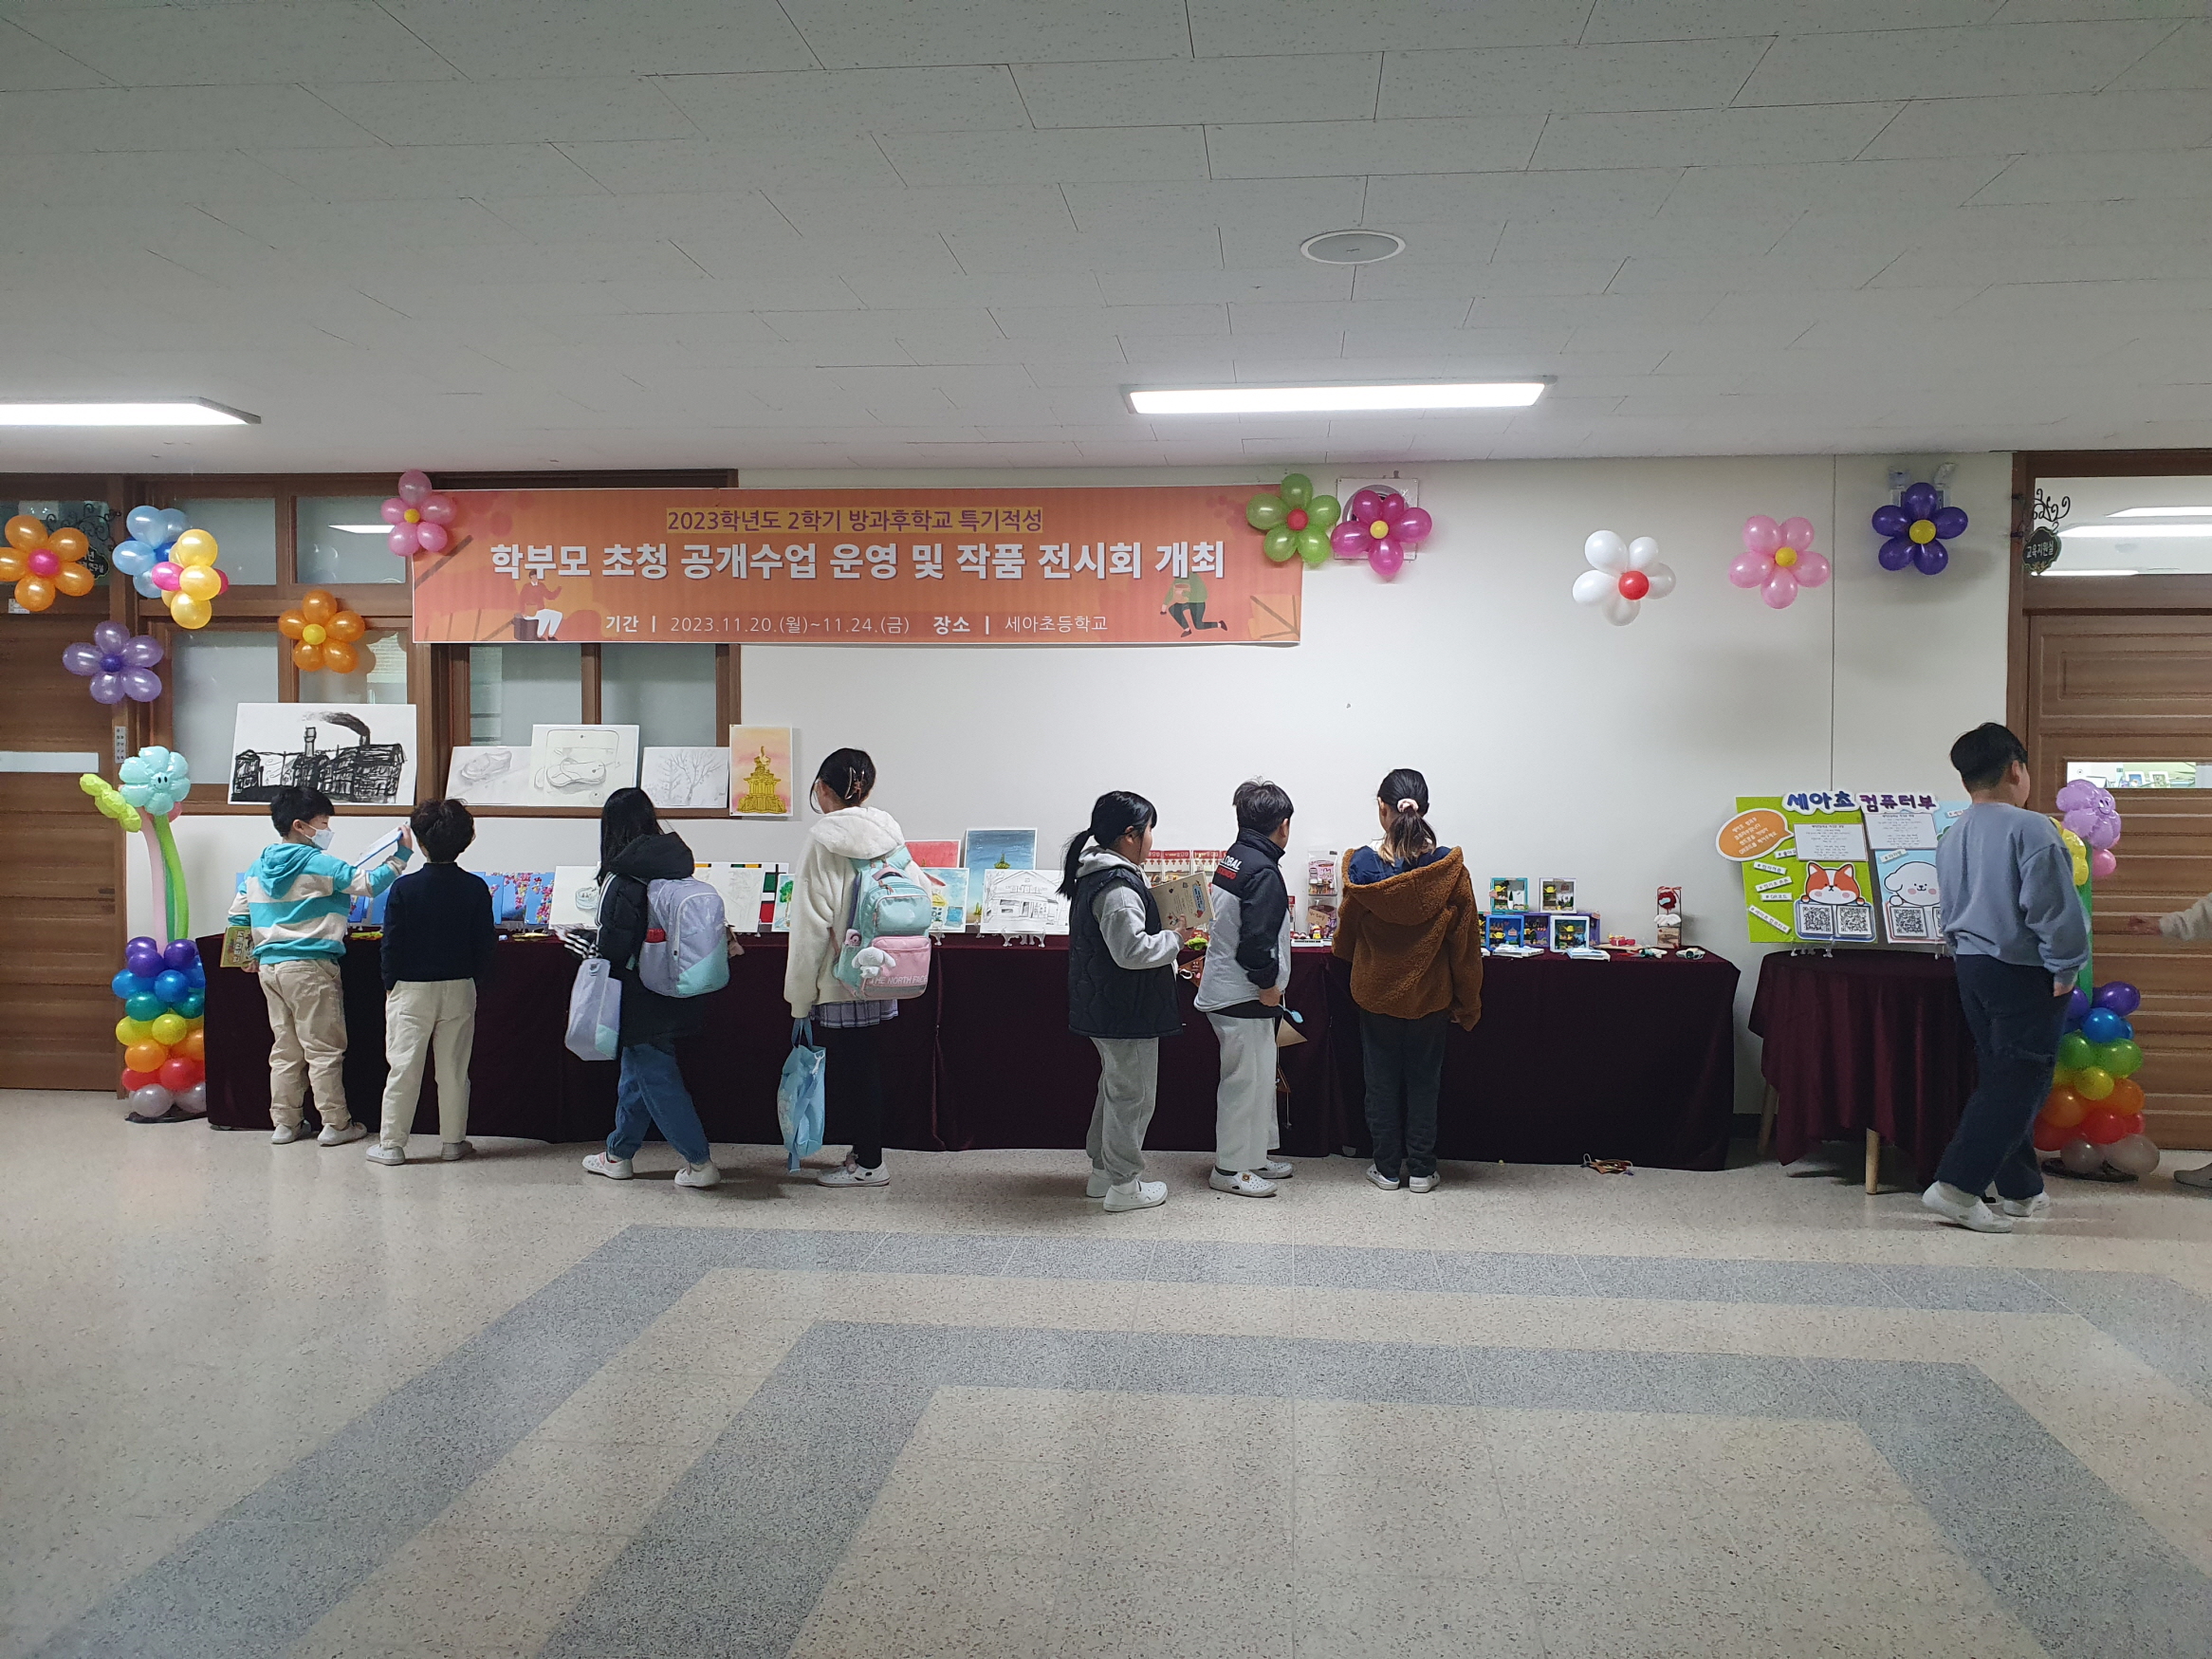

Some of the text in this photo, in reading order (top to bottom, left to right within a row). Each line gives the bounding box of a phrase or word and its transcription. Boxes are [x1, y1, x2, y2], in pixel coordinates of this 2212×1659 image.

[668, 508, 1042, 532] 2023학년도 2학기 방과후학교 특기적성
[2026, 540, 2054, 558] 교육지원실
[490, 541, 1226, 580] 학부모 초청 공개수업 운영 및 작품 전시회 개최
[605, 615, 640, 634] 기간
[932, 615, 971, 636] 장소
[1005, 615, 1109, 634] 세아초등학교
[1786, 790, 1937, 813] 세아초 컴퓨터부
[887, 976, 912, 985] NORTH
[912, 975, 928, 984] FACE
